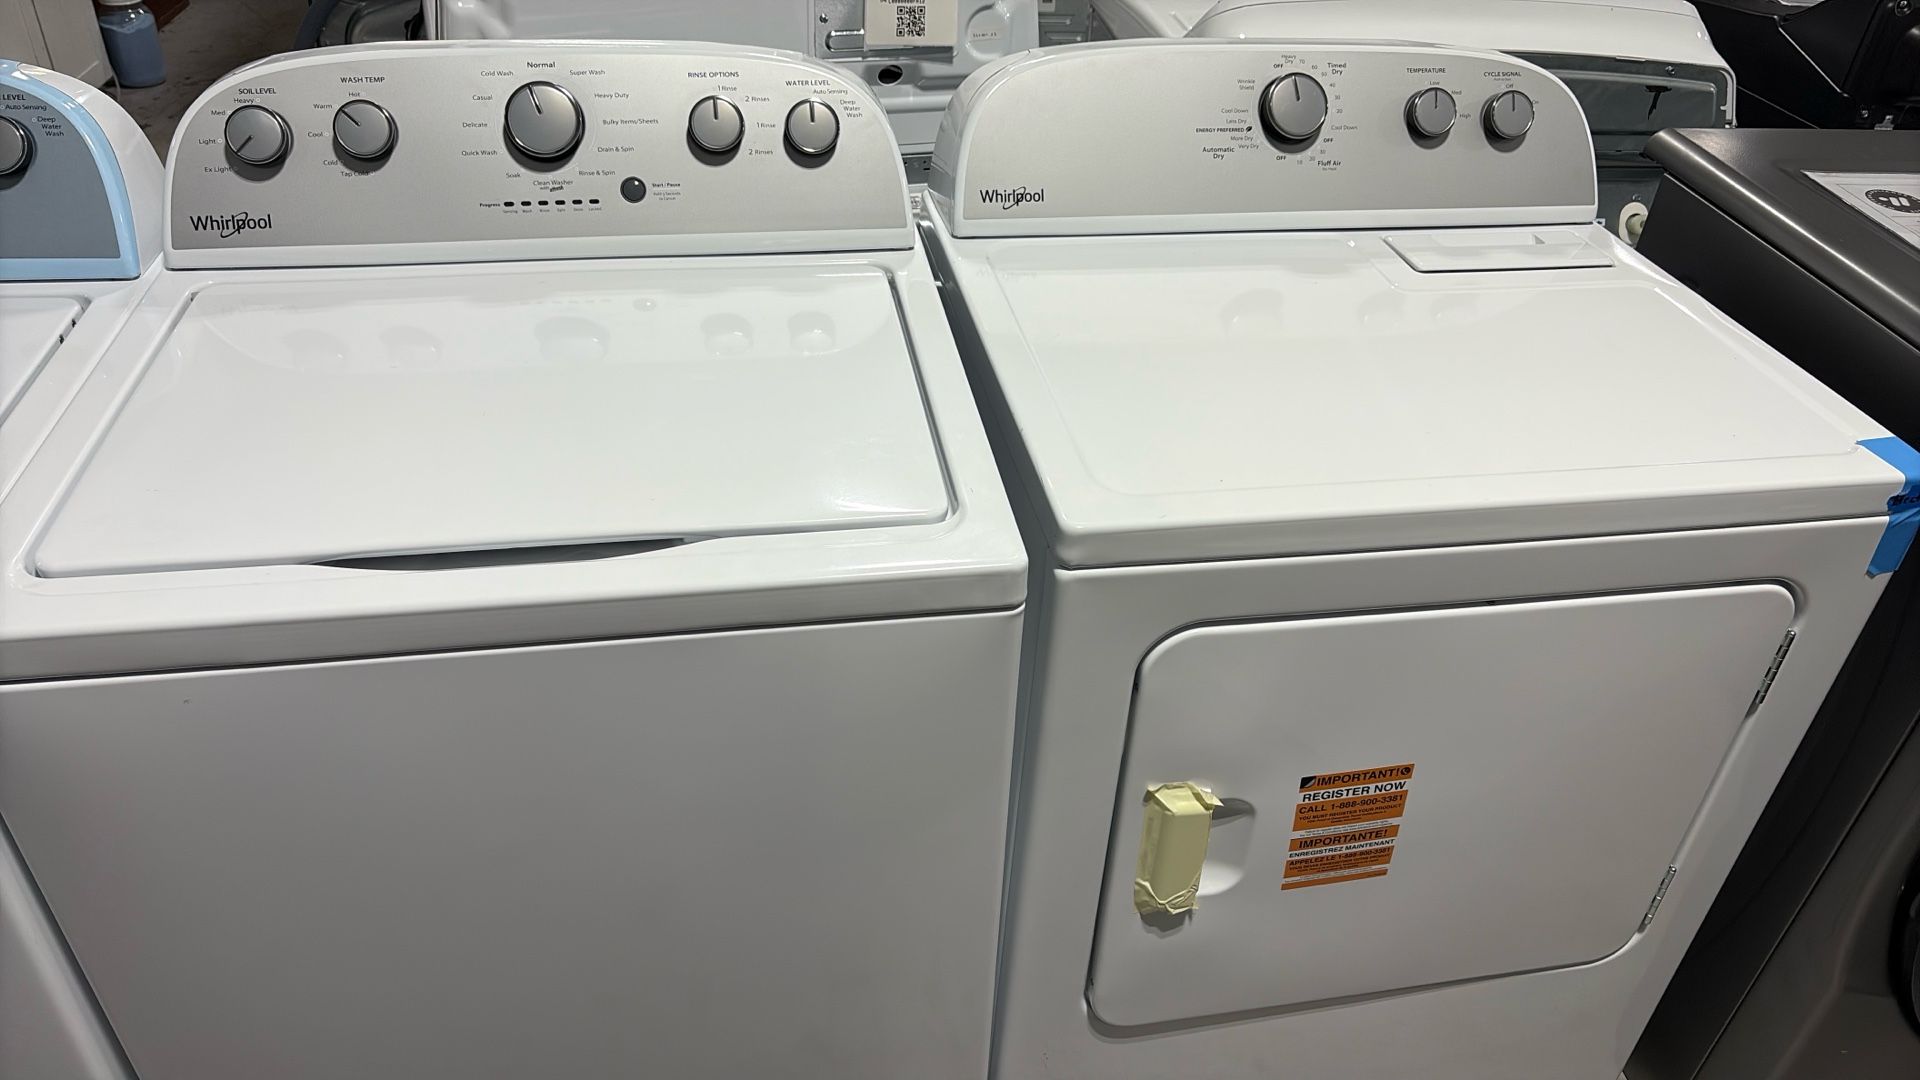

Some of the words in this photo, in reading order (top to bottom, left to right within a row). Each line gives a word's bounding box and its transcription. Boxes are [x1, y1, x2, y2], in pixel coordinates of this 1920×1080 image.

[980, 186, 1044, 210] Whirlpool
[190, 212, 272, 238] Whirlpool
[1316, 768, 1400, 786] IMPORTANT!
[1302, 786, 1371, 802] REGISTER
[1374, 781, 1407, 794] NOW
[1299, 804, 1327, 814] CALL
[1331, 794, 1403, 810] 1-888-900-3381
[1288, 846, 1344, 858] ENREGISTREZ
[1344, 839, 1396, 851] MAINTENANT
[1298, 830, 1388, 848] IMPORTANTE!
[1288, 855, 1325, 866] APPELEZ
[1326, 853, 1338, 861] LE
